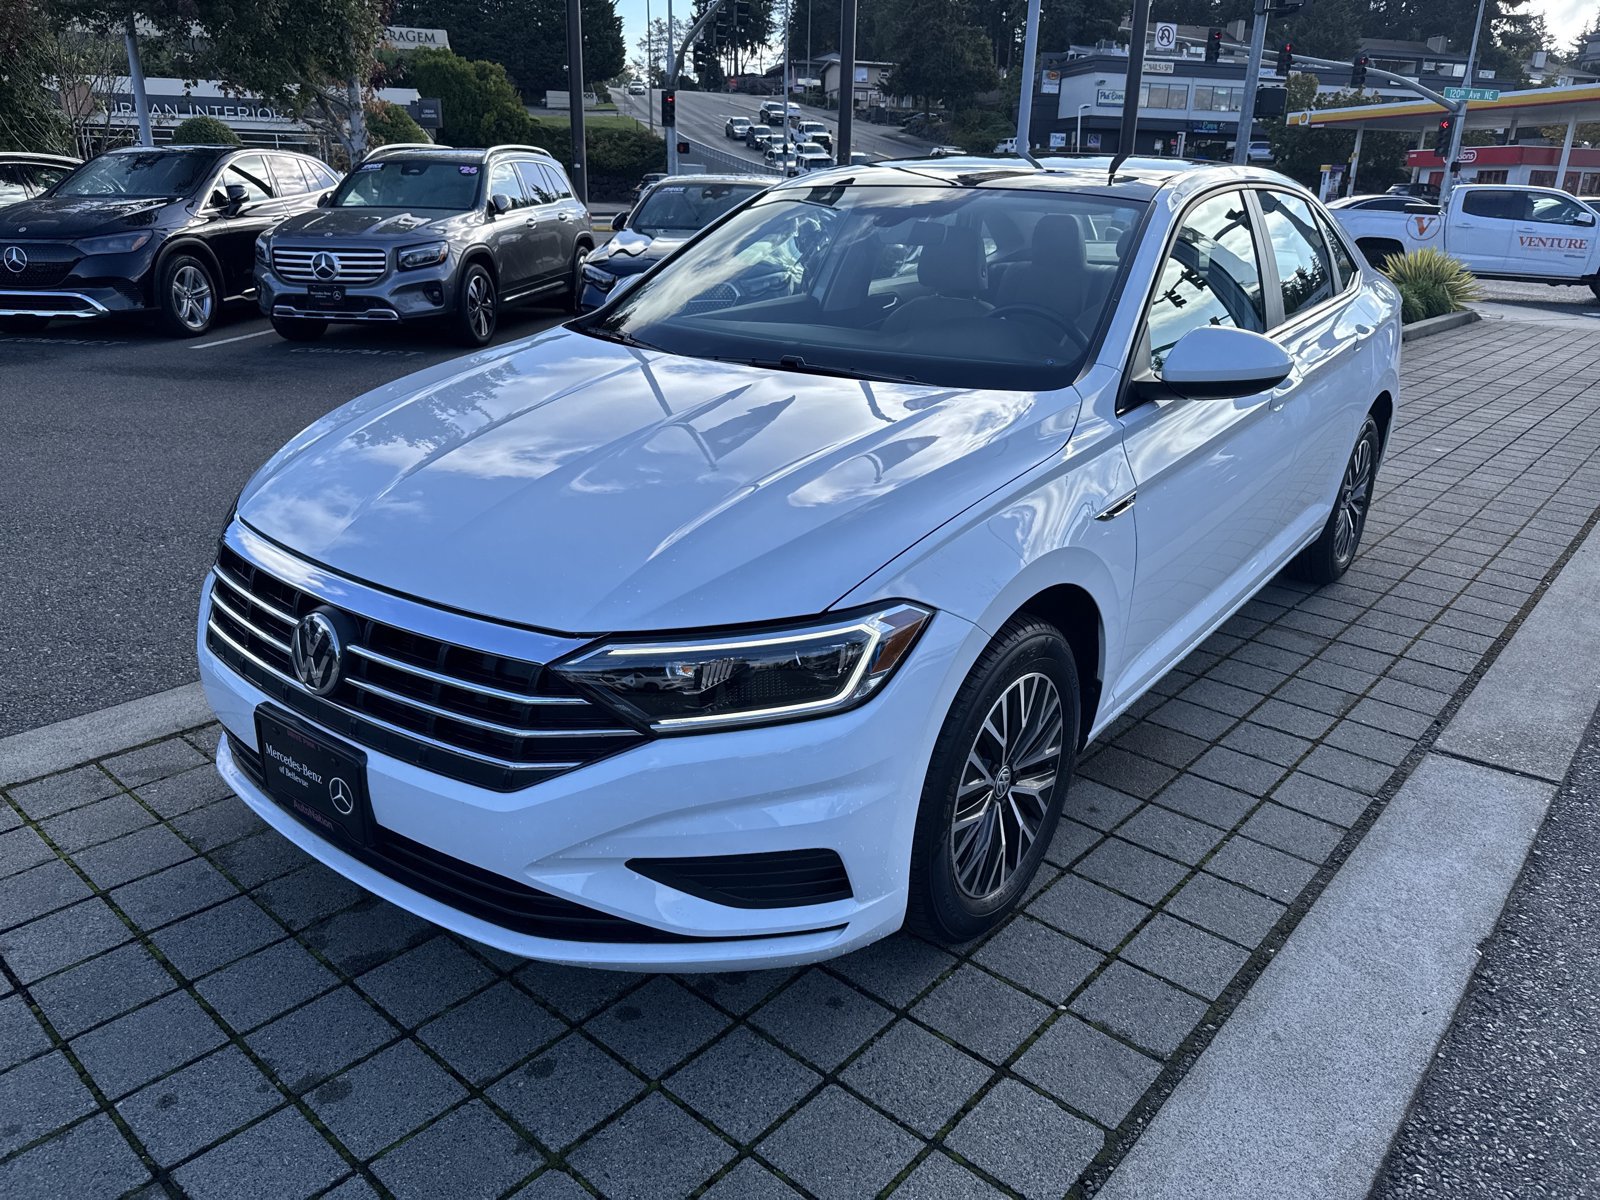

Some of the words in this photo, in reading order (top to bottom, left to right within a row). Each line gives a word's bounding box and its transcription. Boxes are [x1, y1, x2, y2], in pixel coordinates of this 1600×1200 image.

[1449, 89, 1465, 98] 120th
[1468, 90, 1481, 99] Ave
[1484, 91, 1494, 100] NE
[1415, 217, 1436, 236] V
[1519, 235, 1588, 250] VENTURE
[265, 742, 322, 785] Mercedes-Benz
[285, 768, 309, 788] Bellevue
